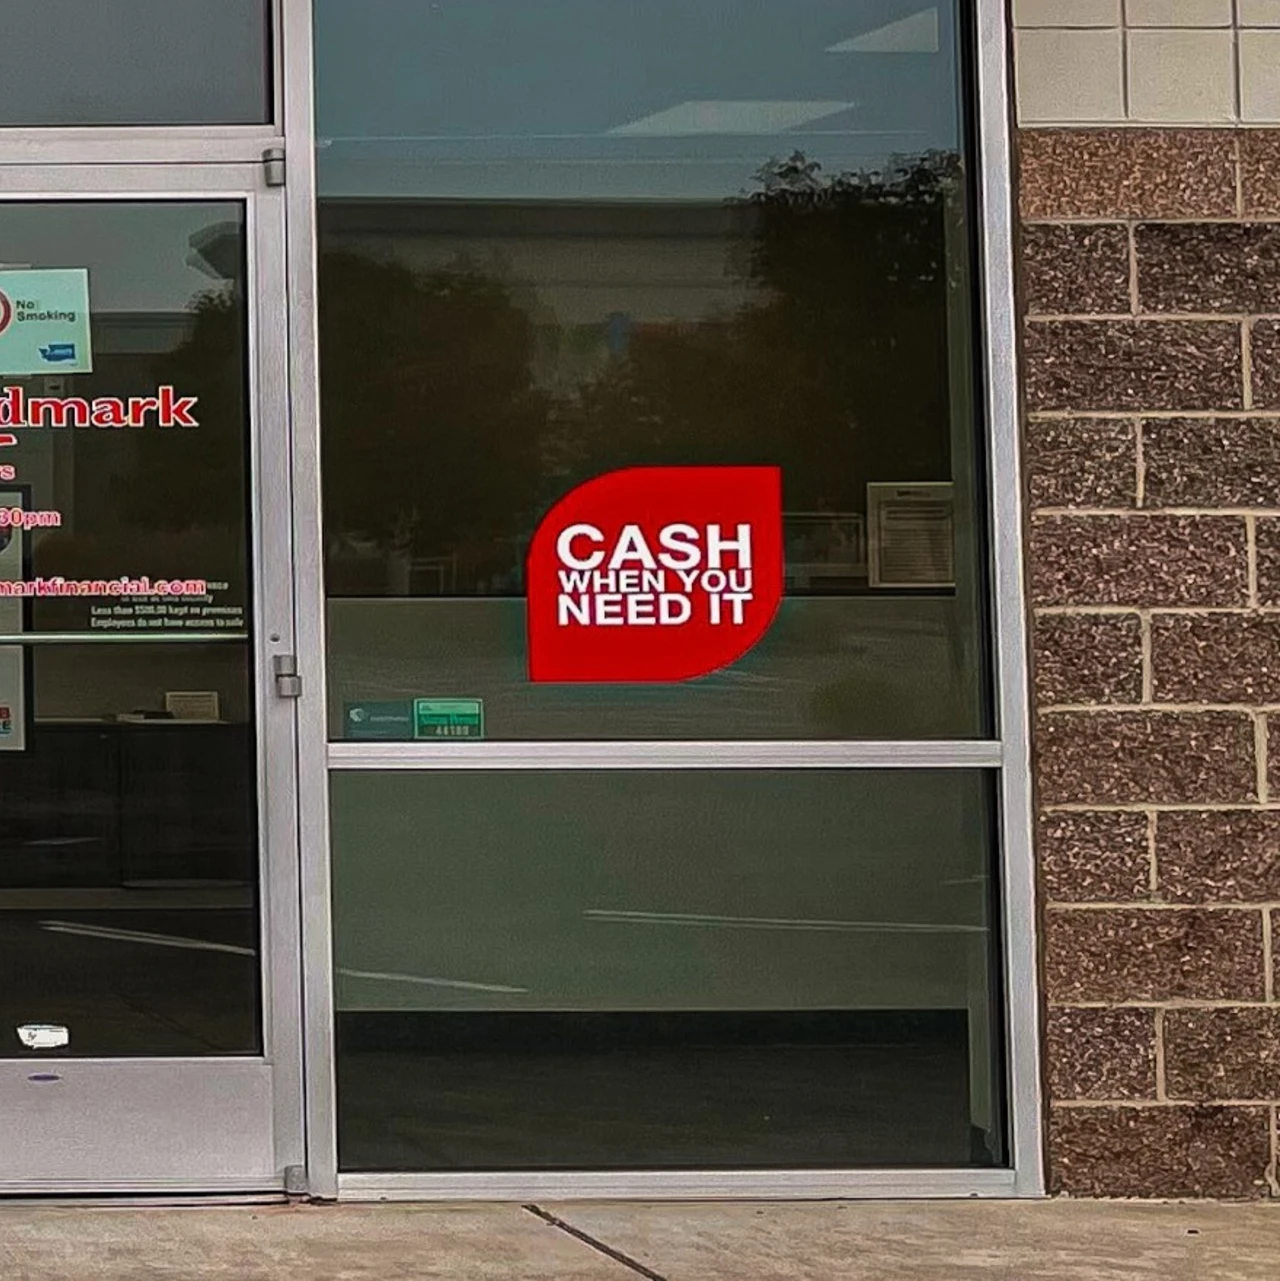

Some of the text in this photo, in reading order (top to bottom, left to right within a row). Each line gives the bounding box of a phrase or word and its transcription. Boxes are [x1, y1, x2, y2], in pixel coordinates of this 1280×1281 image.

[16, 300, 35, 310] No
[17, 310, 76, 323] Smoking
[556, 523, 753, 570] CASH
[558, 570, 753, 593] WHEN YOU
[558, 593, 753, 626] NEED IT
